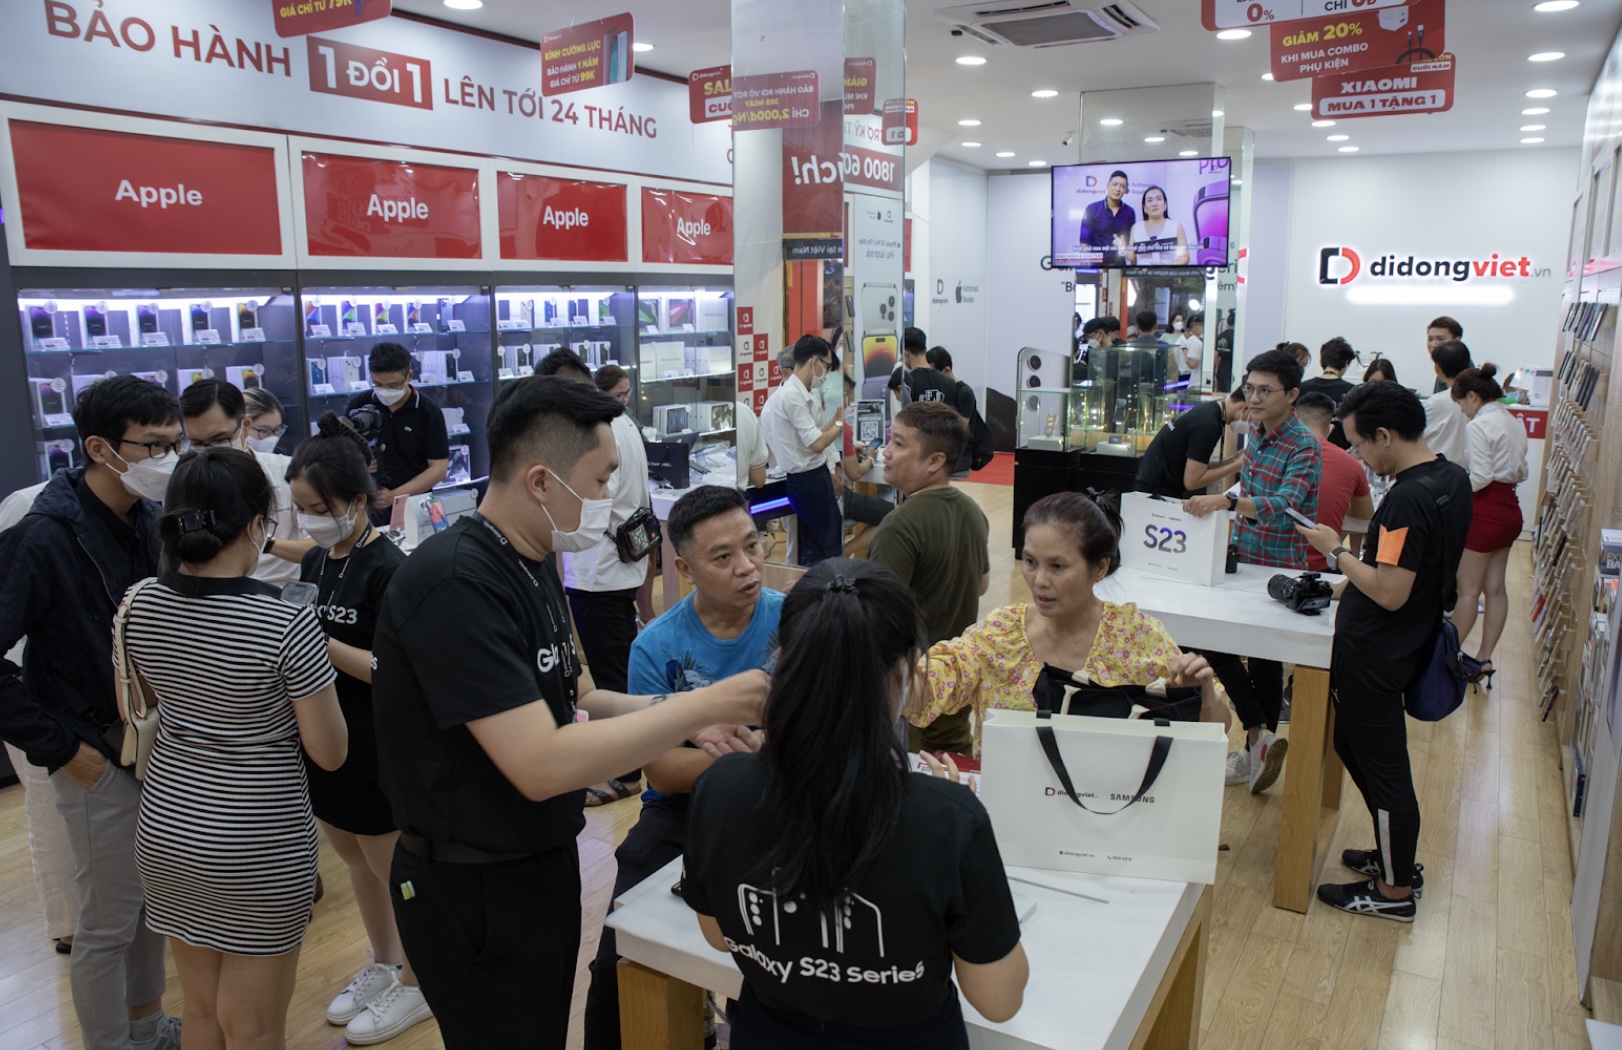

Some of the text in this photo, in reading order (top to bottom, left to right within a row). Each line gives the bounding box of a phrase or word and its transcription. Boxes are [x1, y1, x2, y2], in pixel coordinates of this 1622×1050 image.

[45, 0, 291, 77] BẢO HÀNH
[1282, 22, 1363, 47] GIẢM 20%
[1281, 42, 1368, 64] KHI MUA COMBO
[318, 45, 422, 103] 1 ĐỔI 1
[580, 70, 595, 81] 99K
[1300, 58, 1348, 74] PHỤ KIỆN
[1341, 77, 1417, 94] XIAOMI
[444, 75, 657, 139] LÊN TỚI 24 THÁNG
[1328, 94, 1436, 112] MUA 1 TẶNG 1
[115, 179, 203, 209] Apple
[366, 194, 429, 223] Apple
[543, 206, 589, 229] Apple
[676, 217, 711, 238] Apple
[1144, 524, 1186, 553] S23
[327, 604, 358, 624] S23
[723, 935, 925, 984] Galaxy S23 Series
